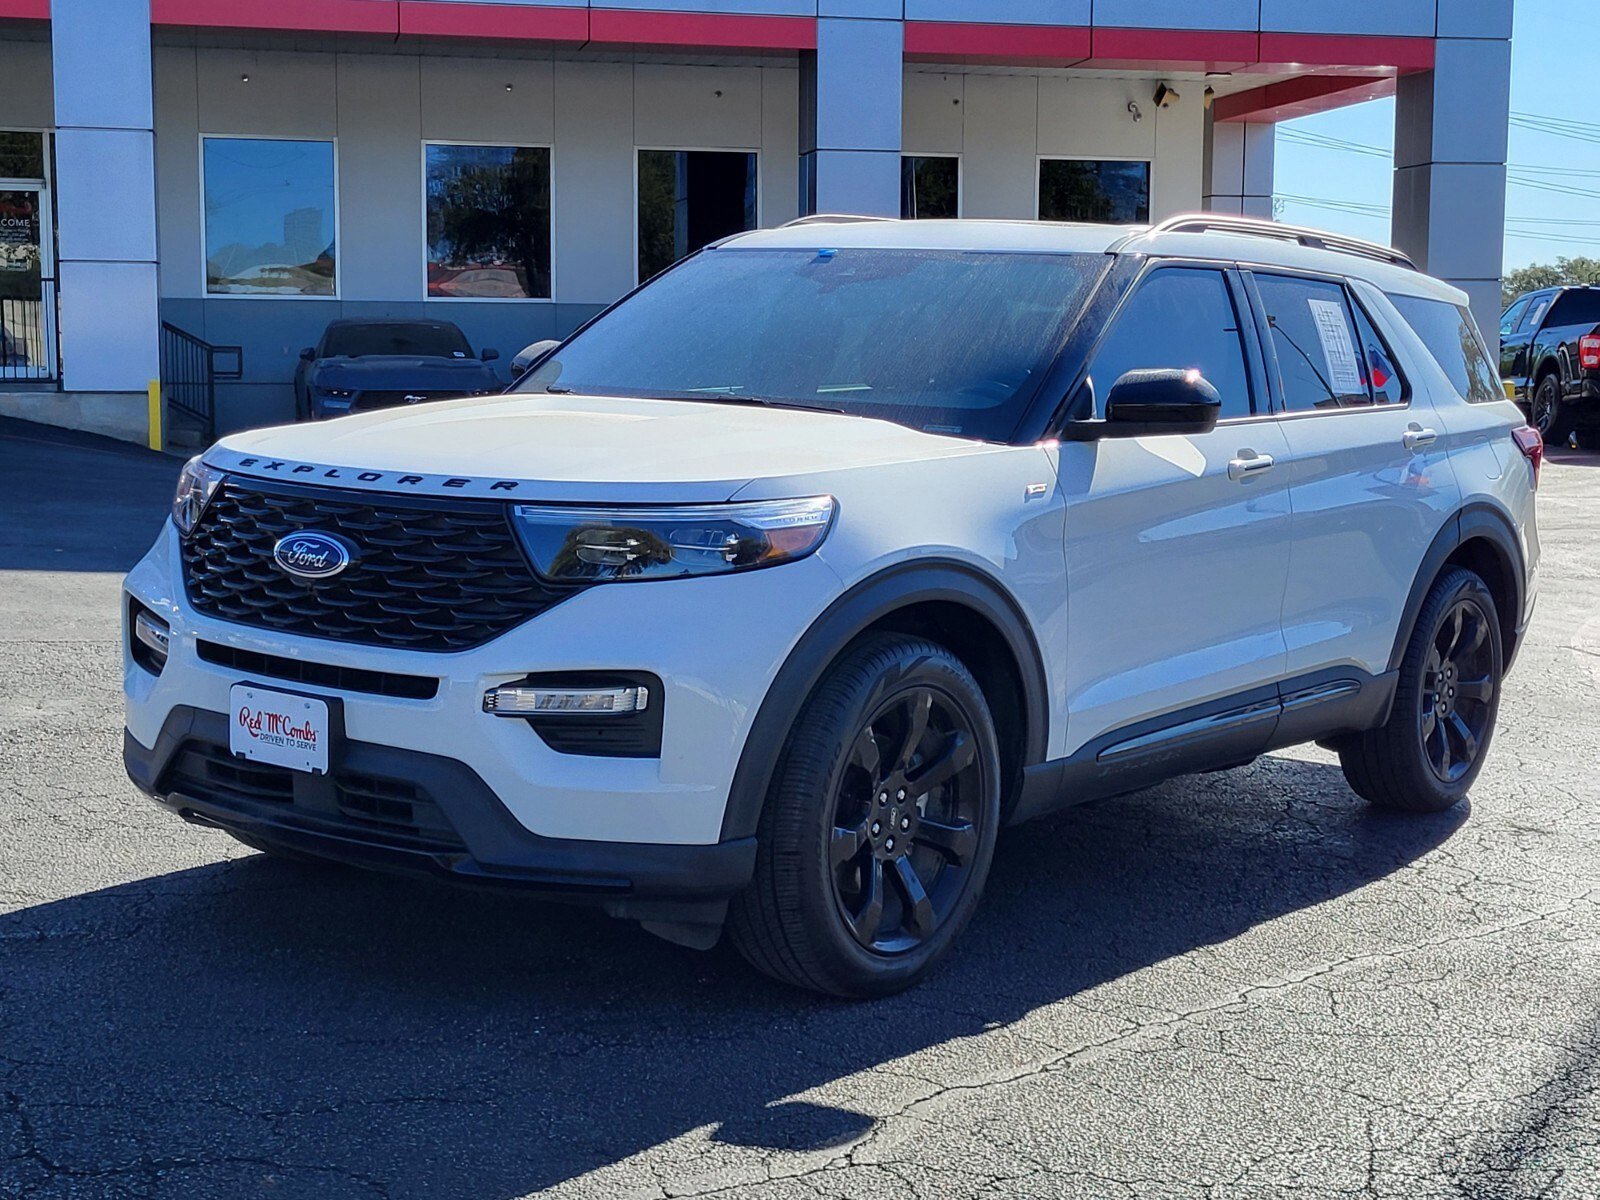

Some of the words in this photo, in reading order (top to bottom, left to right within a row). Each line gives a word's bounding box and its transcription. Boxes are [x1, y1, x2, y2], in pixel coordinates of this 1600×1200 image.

[239, 458, 519, 491] EXPLORER
[287, 541, 329, 567] Ford
[240, 706, 262, 738] Red
[264, 711, 316, 742] McCombs
[260, 733, 284, 744] DRIVEN
[286, 739, 295, 747] TO
[296, 742, 317, 752] SERVE
